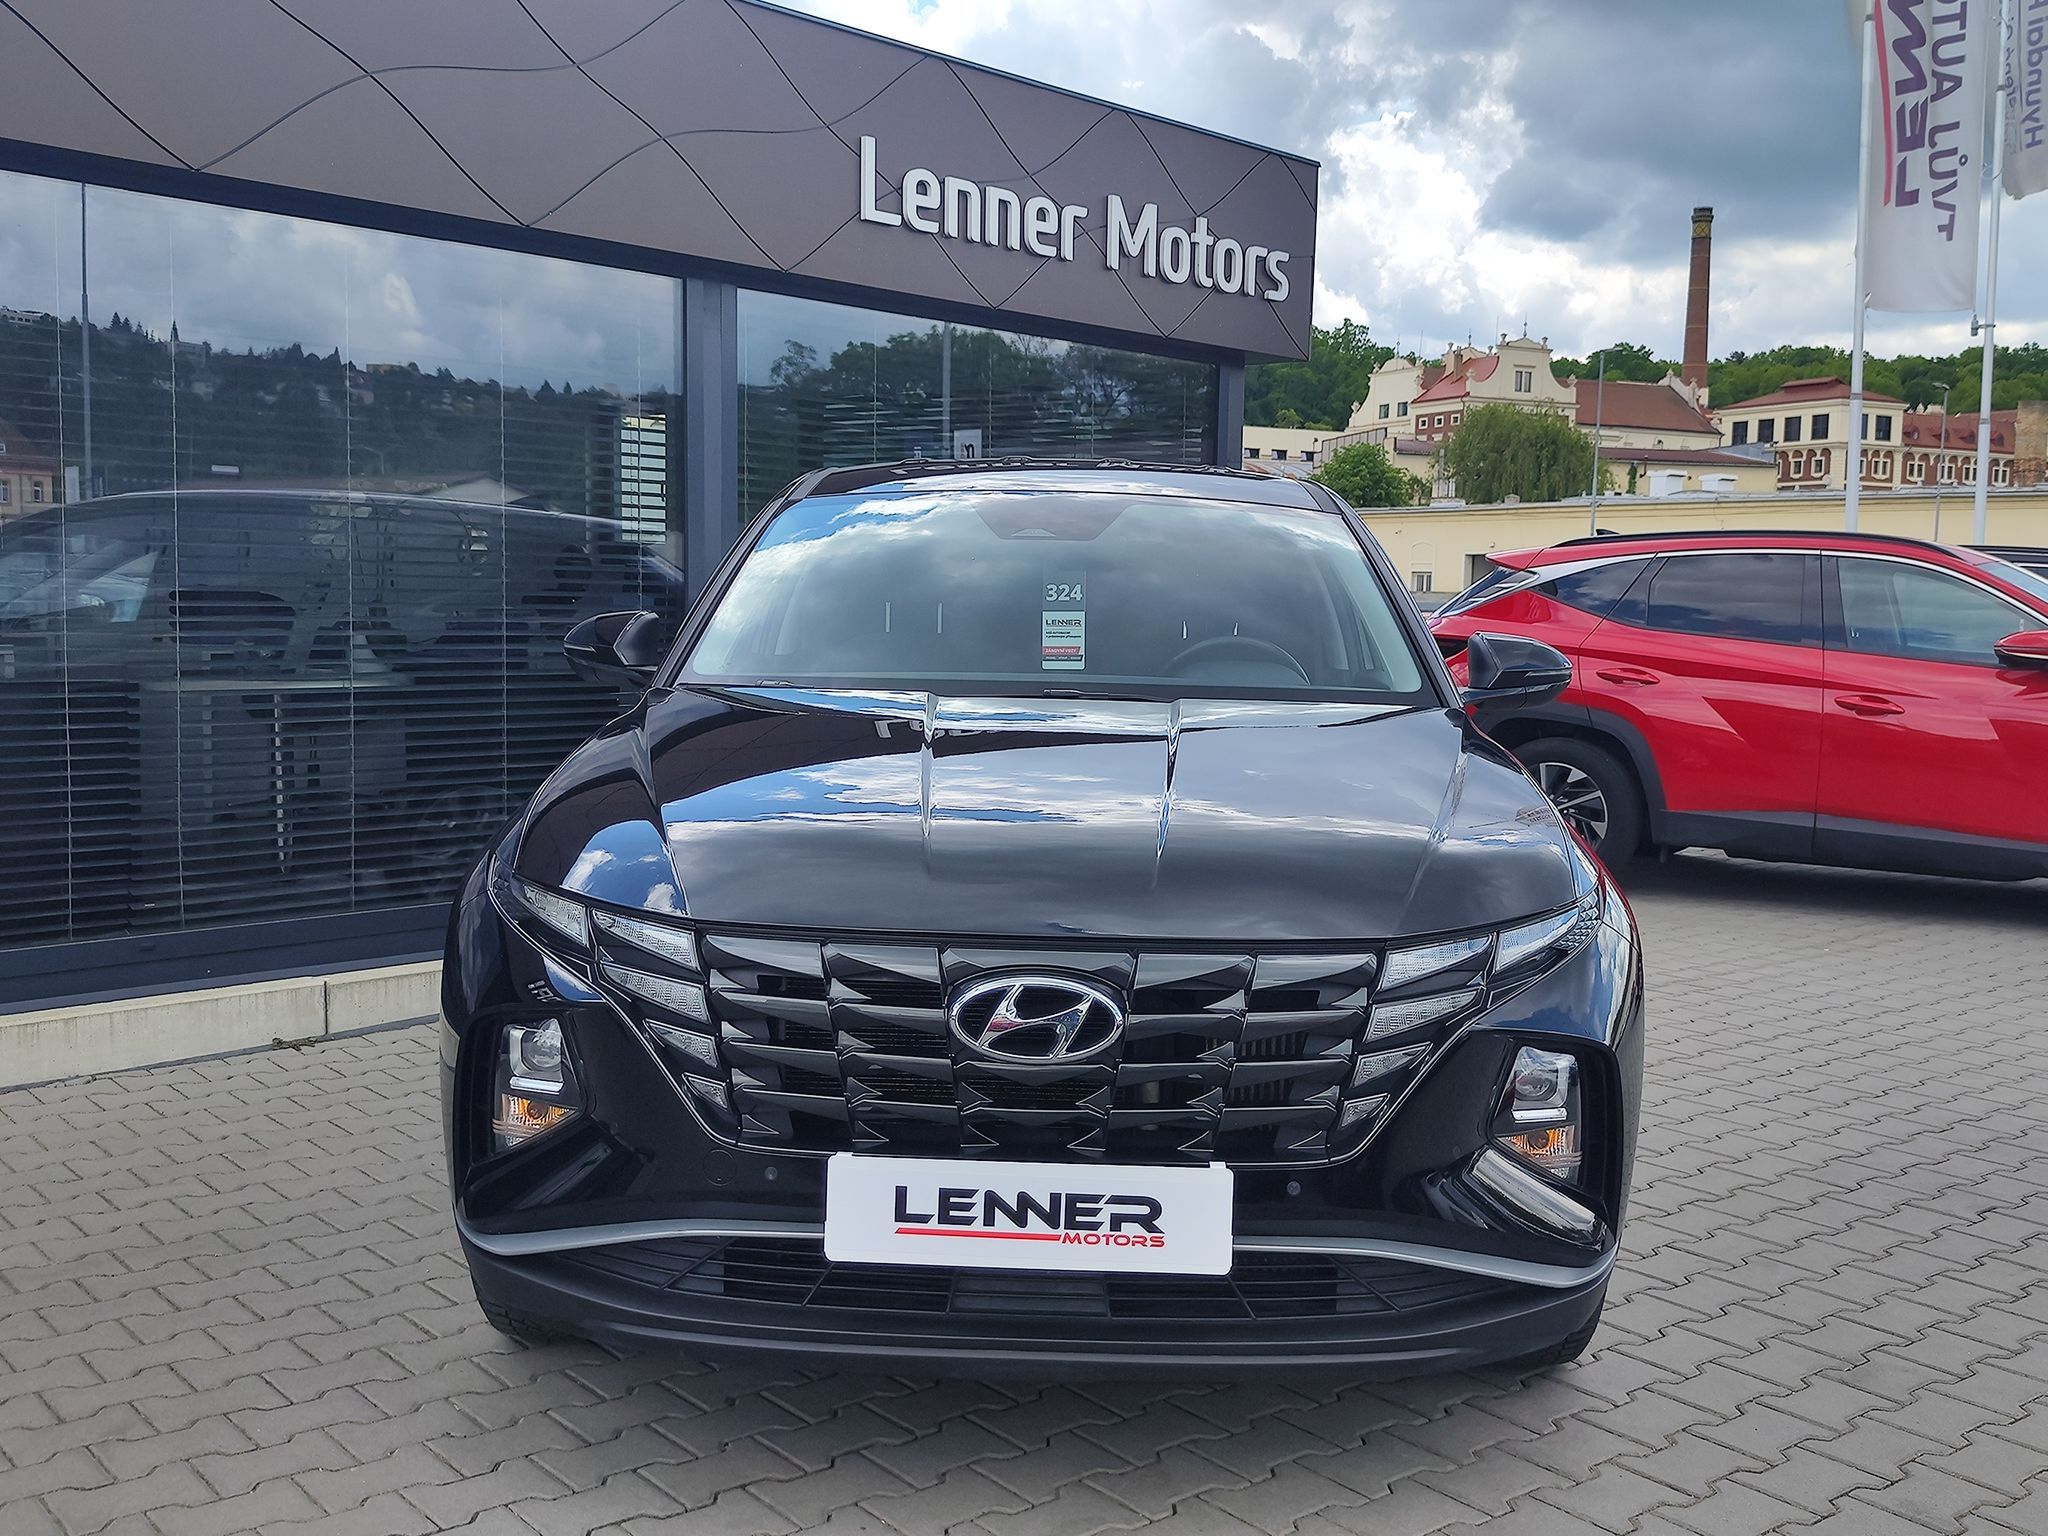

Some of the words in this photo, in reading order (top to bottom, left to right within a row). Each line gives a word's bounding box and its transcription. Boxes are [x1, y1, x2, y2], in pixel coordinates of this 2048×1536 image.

[860, 135, 1088, 262] Lenner
[1106, 194, 1290, 302] Motors
[1045, 583, 1083, 602] 324
[894, 1185, 1163, 1234] LENNER
[1061, 1232, 1166, 1248] MOTORS
